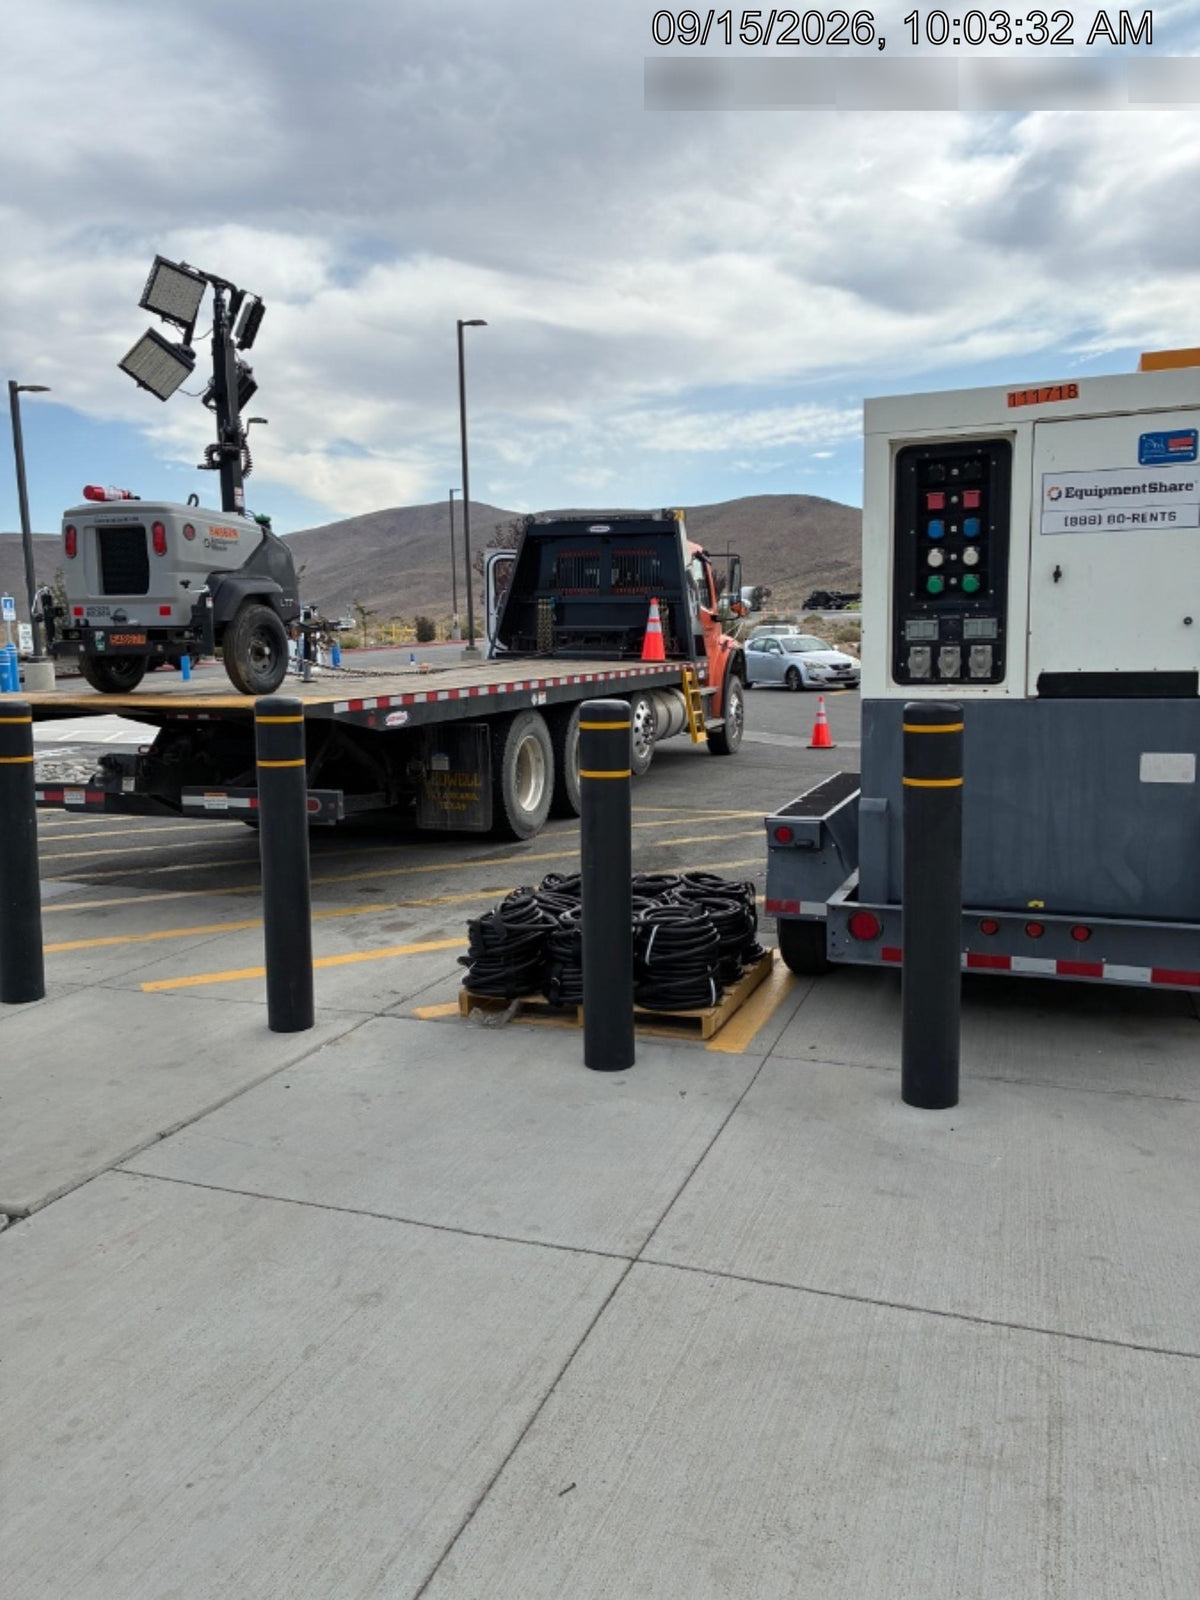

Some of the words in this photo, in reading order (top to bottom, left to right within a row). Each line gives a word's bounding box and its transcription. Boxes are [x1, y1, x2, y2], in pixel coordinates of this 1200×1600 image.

[1010, 384, 1078, 407] 111718
[1065, 482, 1193, 500] EquipmentShare
[1064, 514, 1102, 527] (888)
[1107, 511, 1177, 525] 80-RENTS
